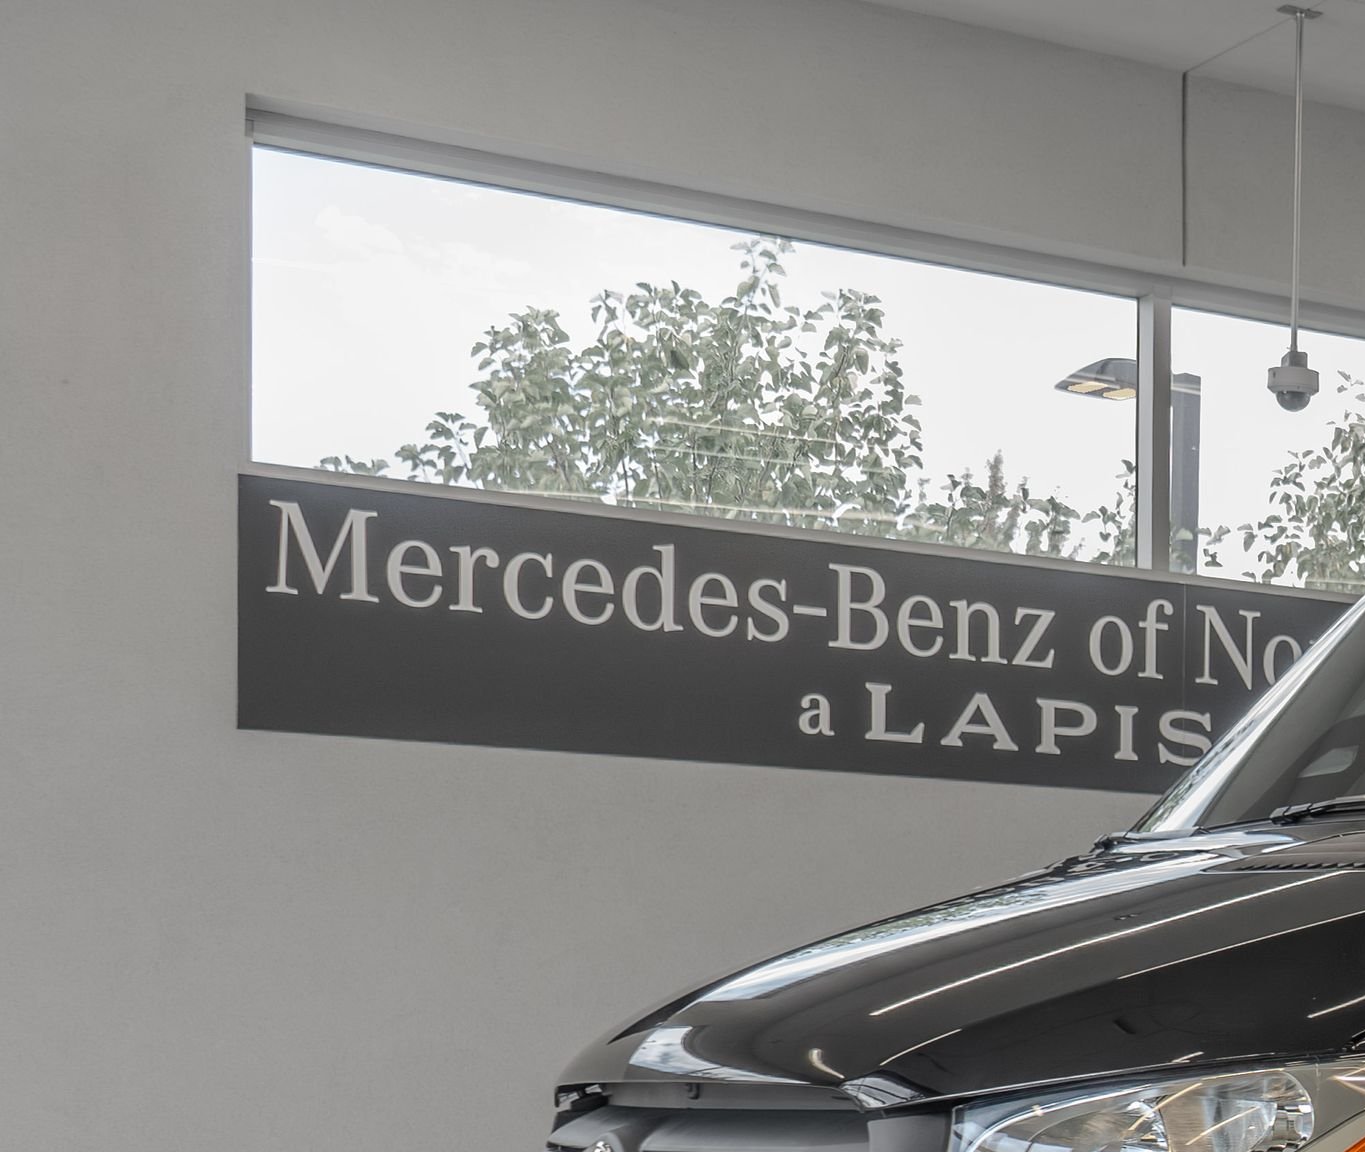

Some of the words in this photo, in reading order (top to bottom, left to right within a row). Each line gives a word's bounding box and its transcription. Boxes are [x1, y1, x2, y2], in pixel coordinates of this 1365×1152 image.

[265, 499, 1056, 671] Mercedes-Benz
[1088, 600, 1173, 680] of
[798, 691, 835, 737] a
[863, 682, 1211, 766] LAPIS
